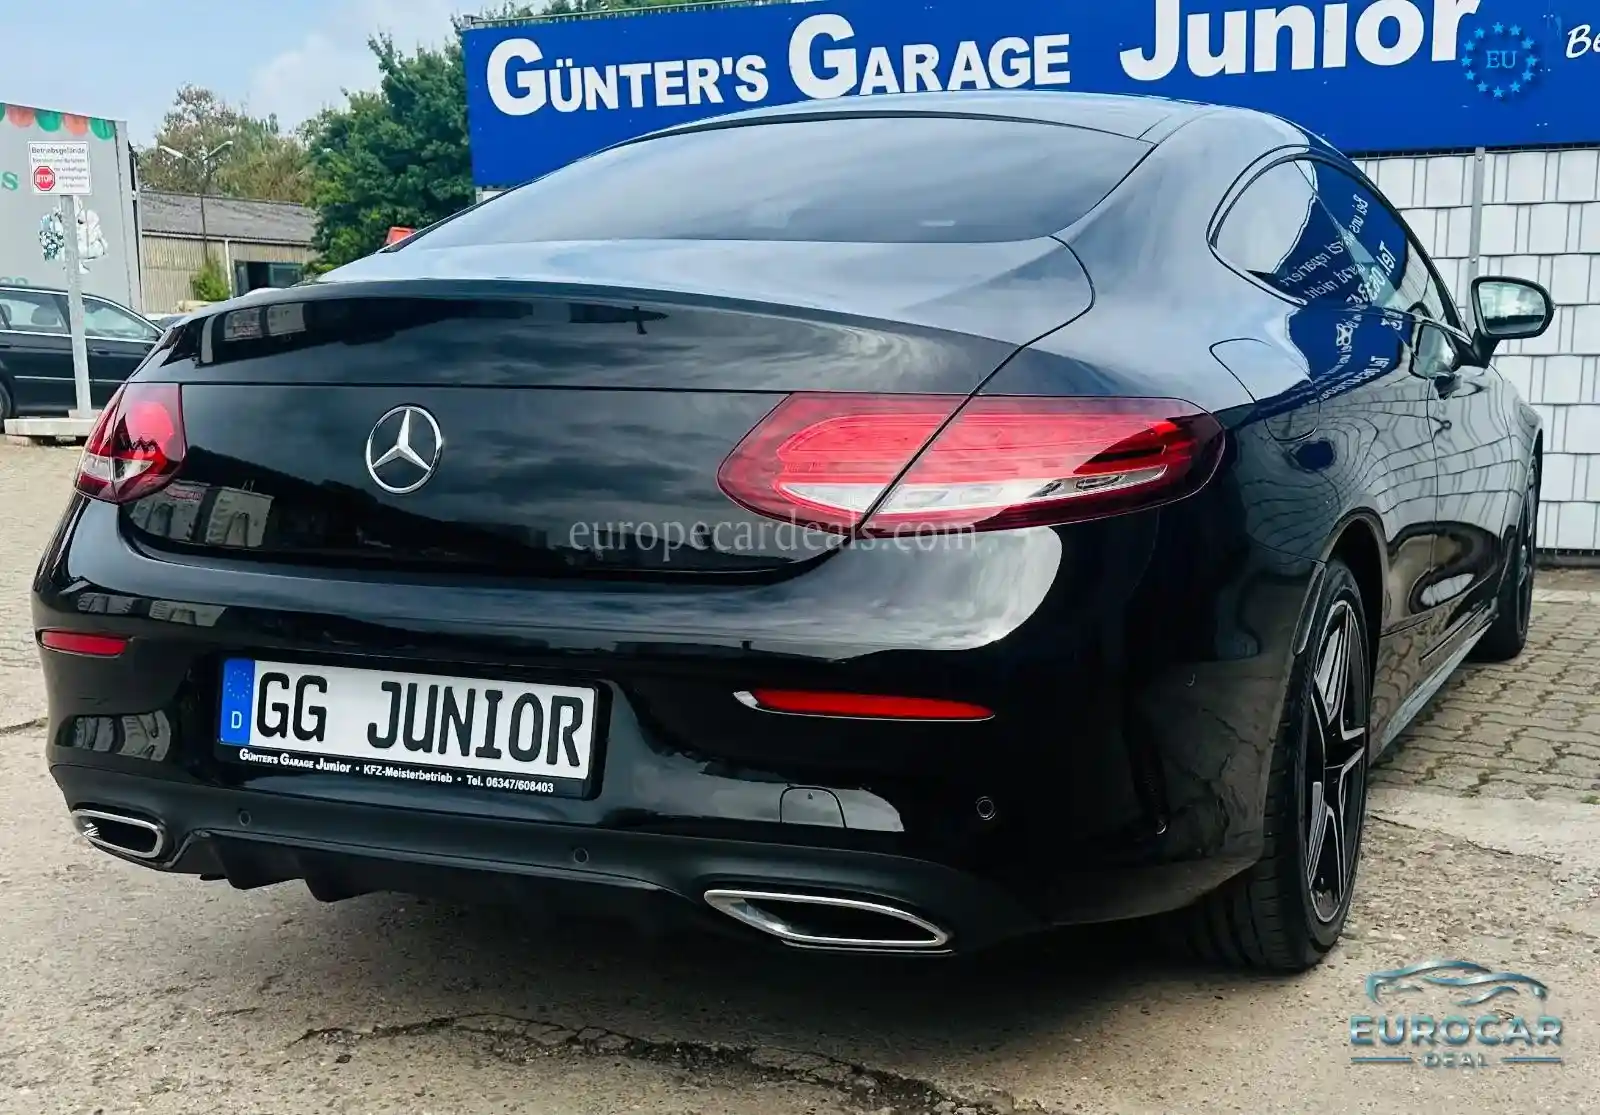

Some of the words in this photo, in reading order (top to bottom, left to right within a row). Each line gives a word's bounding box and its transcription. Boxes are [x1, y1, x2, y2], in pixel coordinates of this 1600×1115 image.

[788, 13, 1071, 98] GARAGE
[1119, 0, 1480, 82] Junior
[31, 146, 86, 155] Betriebsgelände
[36, 174, 53, 183] STOP
[231, 710, 243, 729] D
[256, 672, 328, 742] GG
[366, 681, 584, 767] JUNIOR
[279, 753, 315, 769] GARAGE
[315, 758, 352, 773] Junior
[363, 765, 453, 783] KFZ-Meisterbetrieb
[466, 774, 484, 787] Tel.
[485, 777, 554, 793] 06347/608403
